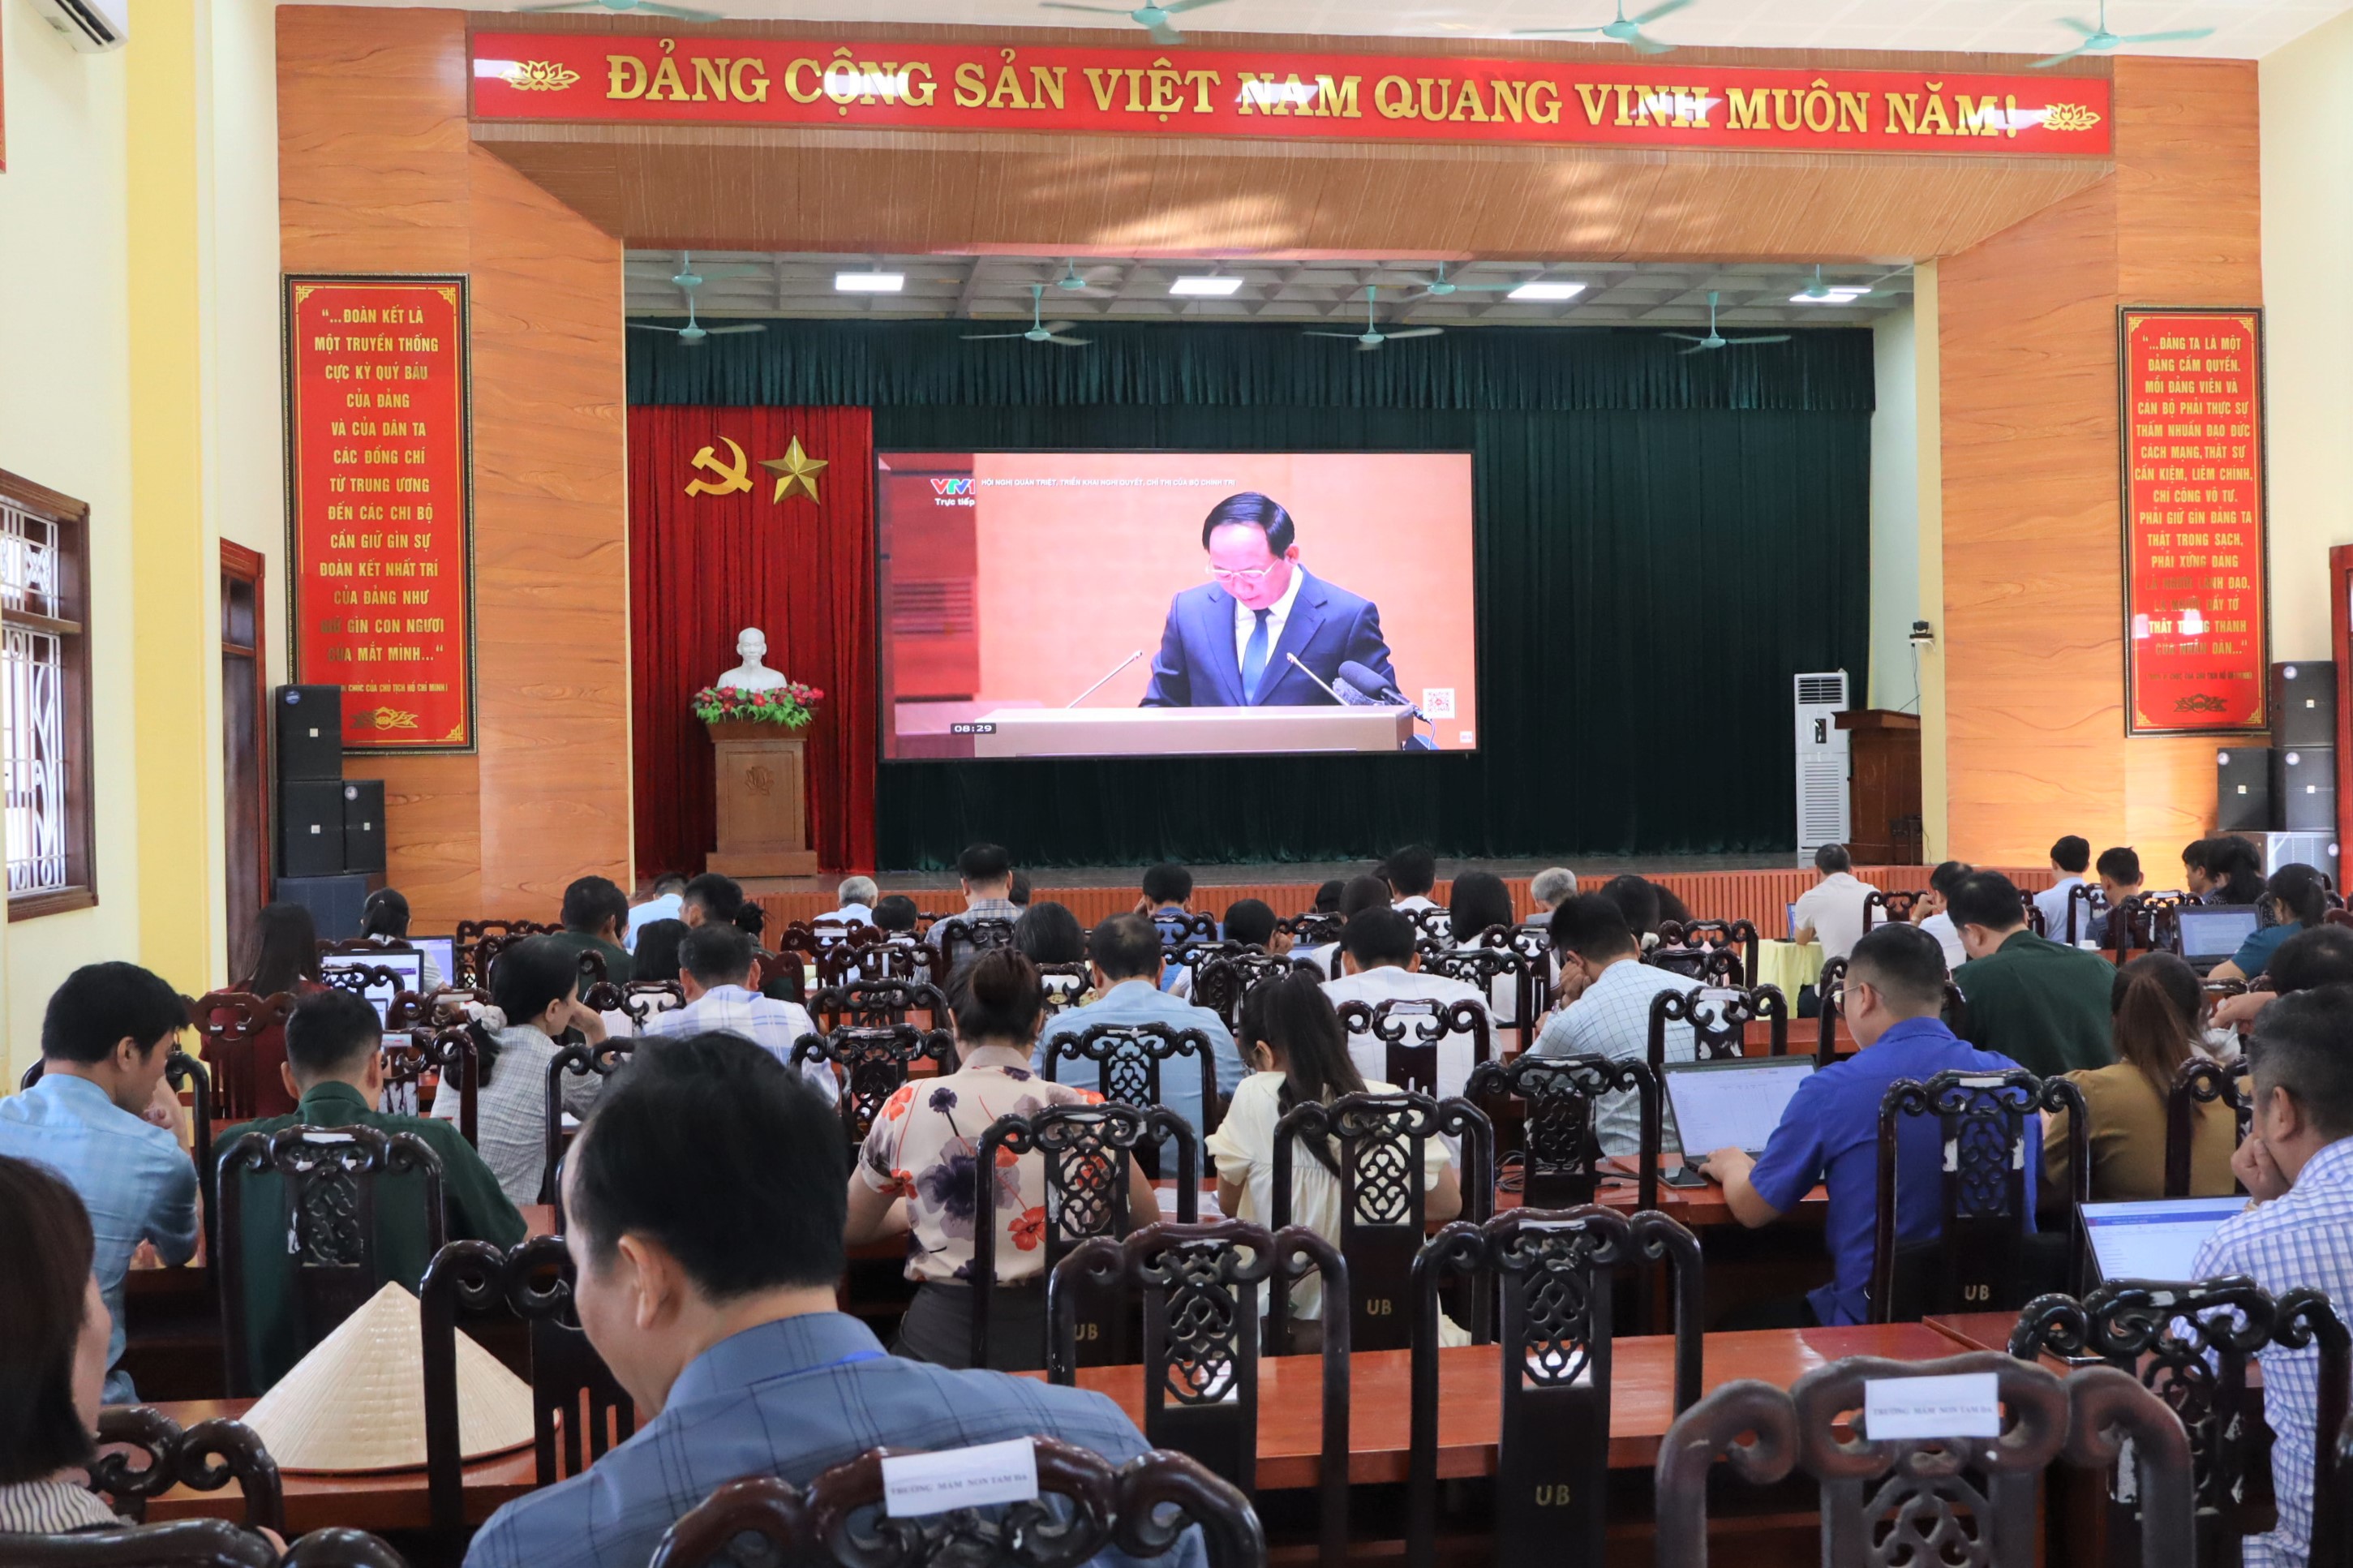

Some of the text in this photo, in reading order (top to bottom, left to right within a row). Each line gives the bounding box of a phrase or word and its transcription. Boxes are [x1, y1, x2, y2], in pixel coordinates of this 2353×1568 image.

[607, 39, 2016, 138] ĐẢNG CỘNG SẢN VIỆT NAM QUANG VINH MUÔN NĂM!
[382, 304, 404, 324] KẾT
[409, 306, 423, 324] LÀ
[315, 333, 438, 354] MỘT TRUYỀN THỐNG
[2189, 337, 2200, 350] TA
[2205, 335, 2217, 350] LÀ
[2222, 335, 2241, 353] MỘT
[325, 362, 427, 382] CỰC KỲ QUÝ BÁU
[2149, 354, 2175, 372] ĐẢNG
[2169, 376, 2195, 393] ĐẢNG
[2200, 378, 2222, 393] VIÊN
[2226, 378, 2238, 393] VÀ
[346, 388, 410, 407] CỦA ĐẢNG
[2138, 397, 2248, 418] CÁN BỘ PHẢI THỰC SỰ
[332, 416, 426, 436] VÀ CỦA DÂN TA
[2136, 420, 2162, 436] THẤM
[2206, 425, 2225, 440] ĐẠO
[2231, 422, 2250, 436] ĐỨC
[333, 445, 425, 464] CÁC ĐỒNG CHÍ
[2141, 444, 2246, 462] CÁCH MẠNG, THẬT SỰ
[330, 474, 430, 492] TỪ TRUNG ƯƠNG
[2159, 466, 2187, 483] KIỆM,
[2192, 466, 2214, 480] LIÊM
[930, 478, 975, 495] VTV1
[2153, 487, 2170, 502] CHÍ
[2175, 487, 2201, 502] CÔNG
[2206, 487, 2218, 502] VÔ
[934, 497, 955, 506] Trực
[328, 501, 433, 523] ĐẾN CÁC CHI BỘ
[2140, 507, 2162, 524] PHẢI
[2188, 509, 2205, 524] GÌN
[2211, 506, 2236, 524] ĐẢNG
[2241, 512, 2252, 523] TA
[331, 529, 431, 552] CẦN GIỮ GÌN SỰ
[2148, 531, 2170, 550] THẬT
[2177, 534, 2209, 546] TRONG
[320, 557, 438, 576] ĐOÀN KẾT NHẤT TRÍ
[2151, 550, 2174, 568] PHẢI
[334, 585, 430, 604] CỦA ĐẢNG NHƯ
[347, 616, 368, 633] GÌN
[376, 619, 400, 633] CON
[358, 642, 382, 661] MẮT
[954, 724, 992, 733] 08:29
[1964, 1285, 1989, 1300] UB
[1367, 1299, 1392, 1316] UB
[1075, 1323, 1098, 1340] UB
[1535, 1484, 1569, 1506] UB
